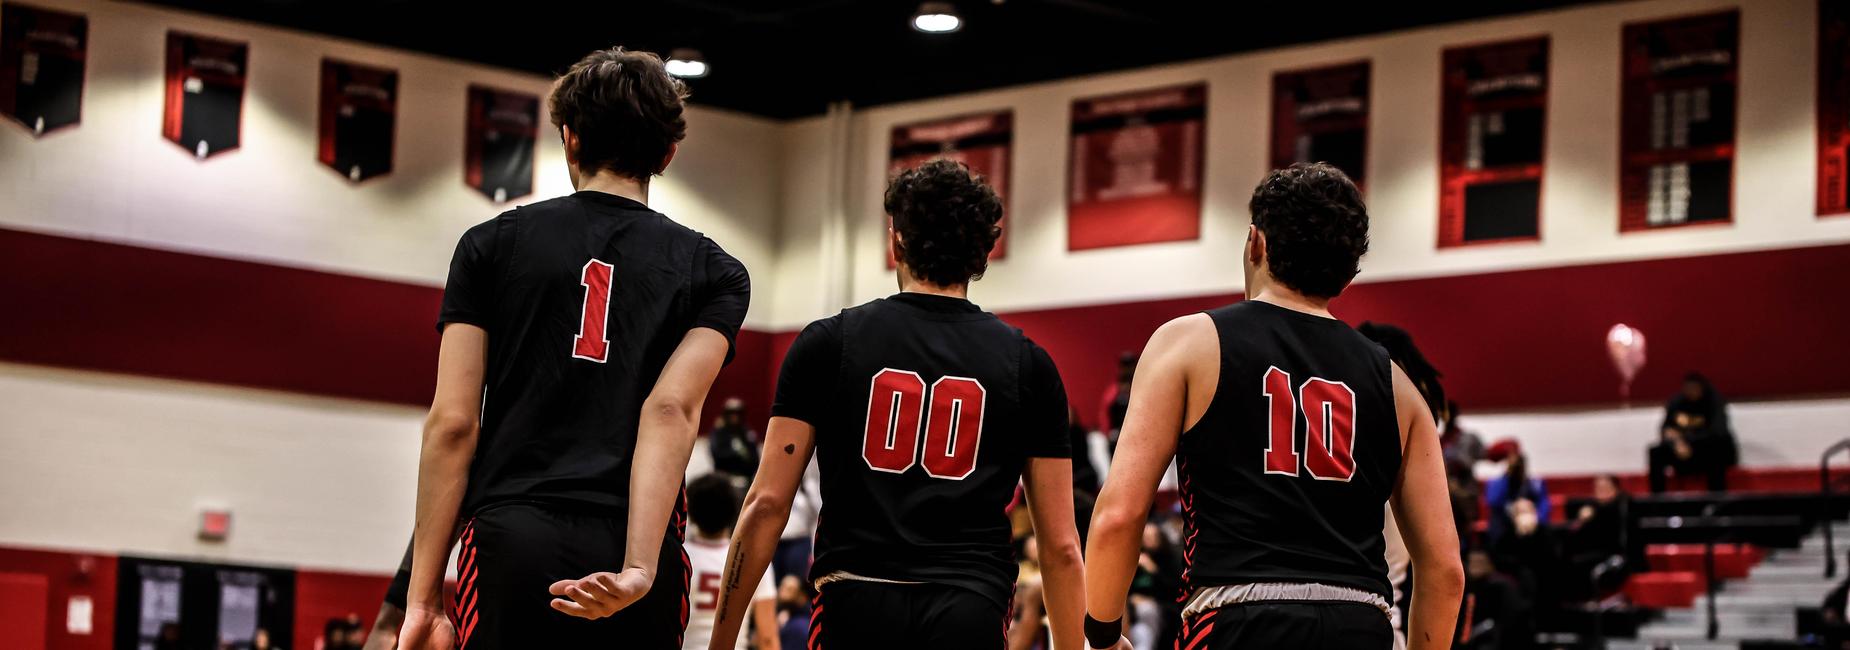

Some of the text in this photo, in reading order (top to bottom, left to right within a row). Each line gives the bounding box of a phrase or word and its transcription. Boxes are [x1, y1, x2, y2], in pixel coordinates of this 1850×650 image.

[572, 258, 614, 363] 1
[863, 368, 986, 480] 00
[1263, 366, 1356, 482] 10
[695, 572, 722, 610] 5
